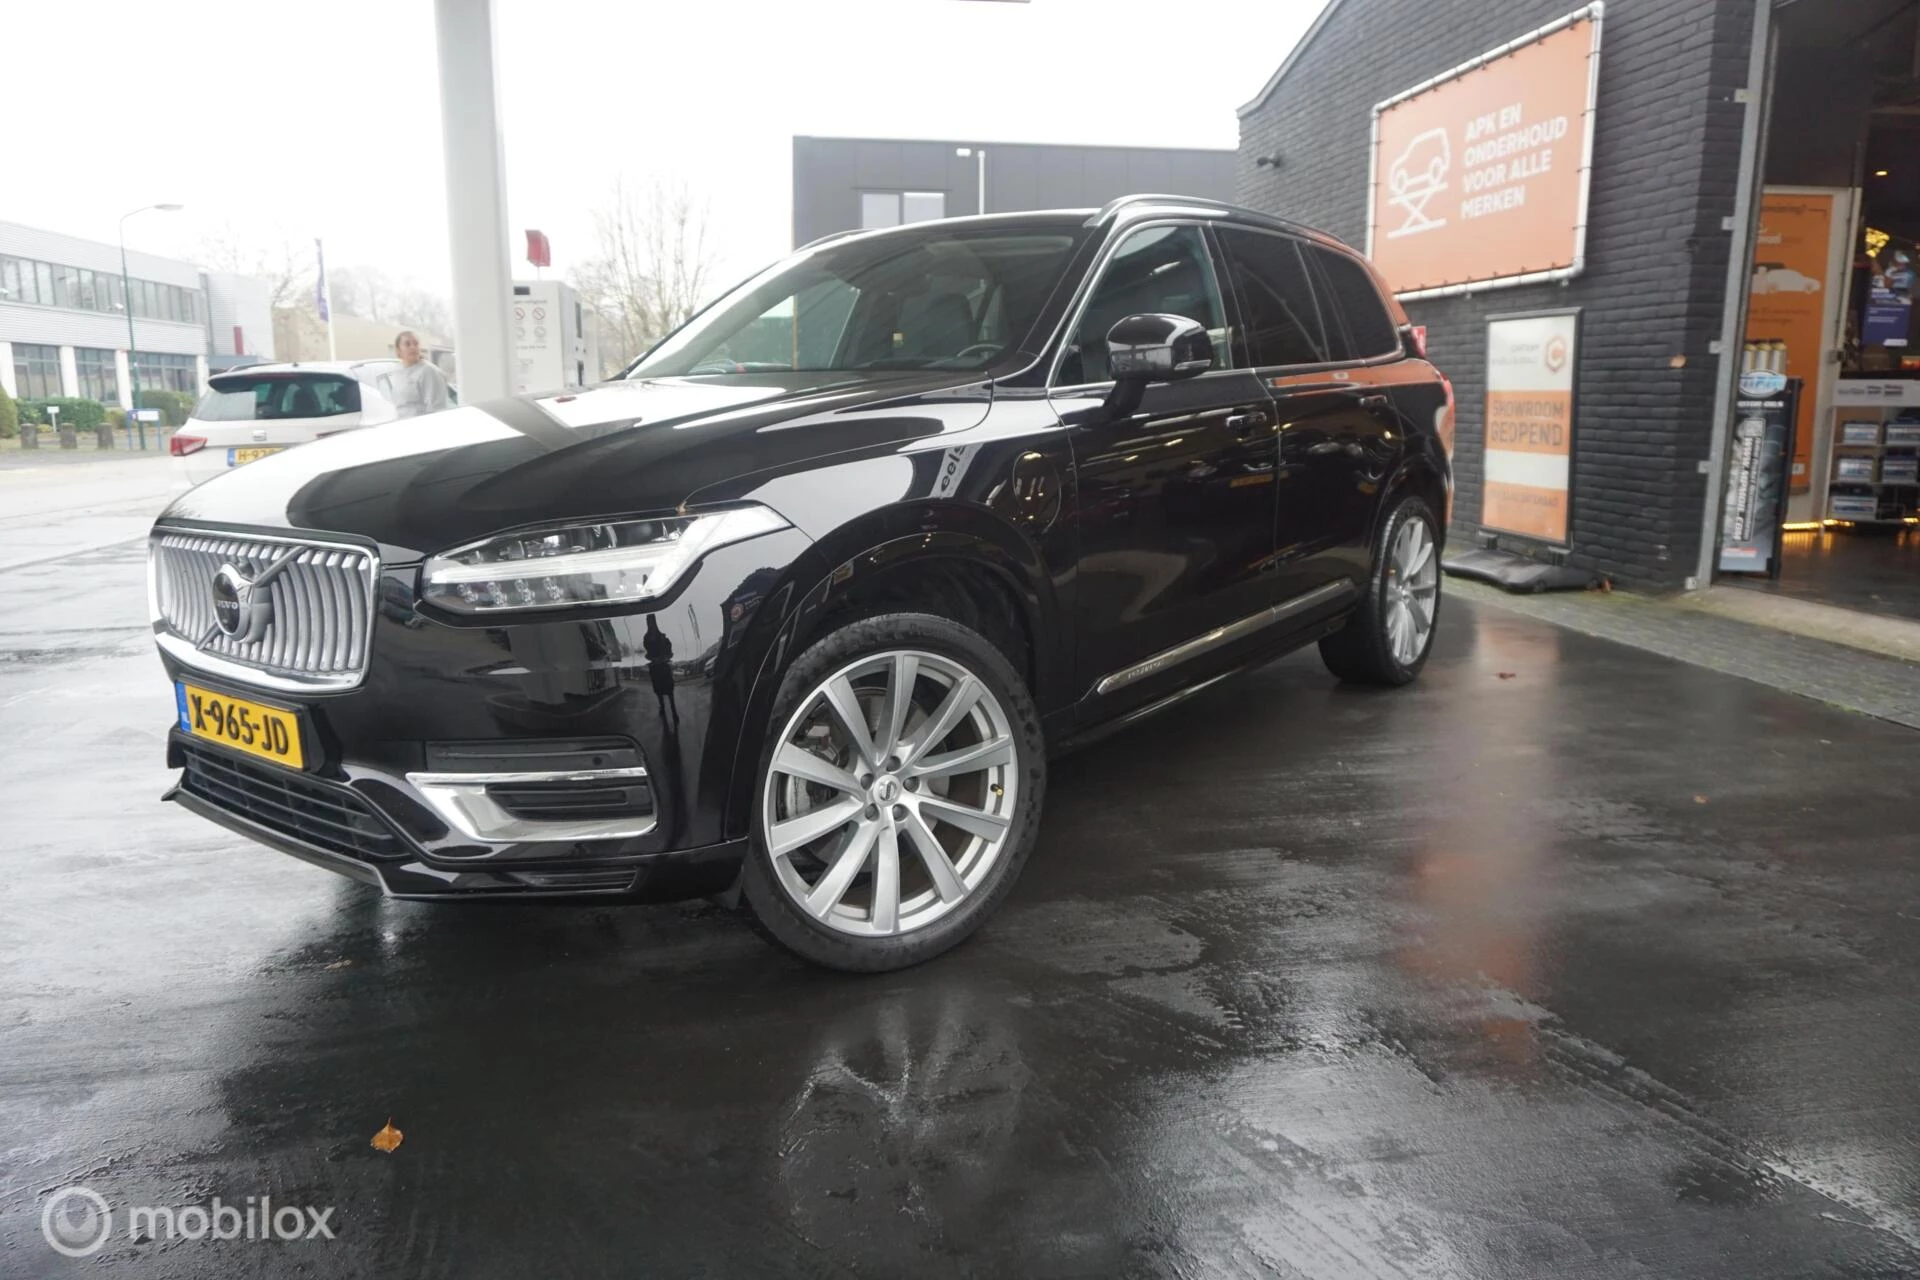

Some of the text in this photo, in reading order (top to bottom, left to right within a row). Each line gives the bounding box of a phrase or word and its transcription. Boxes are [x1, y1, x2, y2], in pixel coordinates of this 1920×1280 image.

[1463, 116, 1568, 168] ONDERHOUD
[1464, 102, 1523, 143] APK EN
[1463, 148, 1552, 193] VOOR ALLE
[1460, 184, 1525, 220] MERKEN
[1492, 400, 1564, 419] SHOWROOM
[1490, 419, 1564, 446] GEOPEND
[190, 693, 290, 756] X-965-JD
